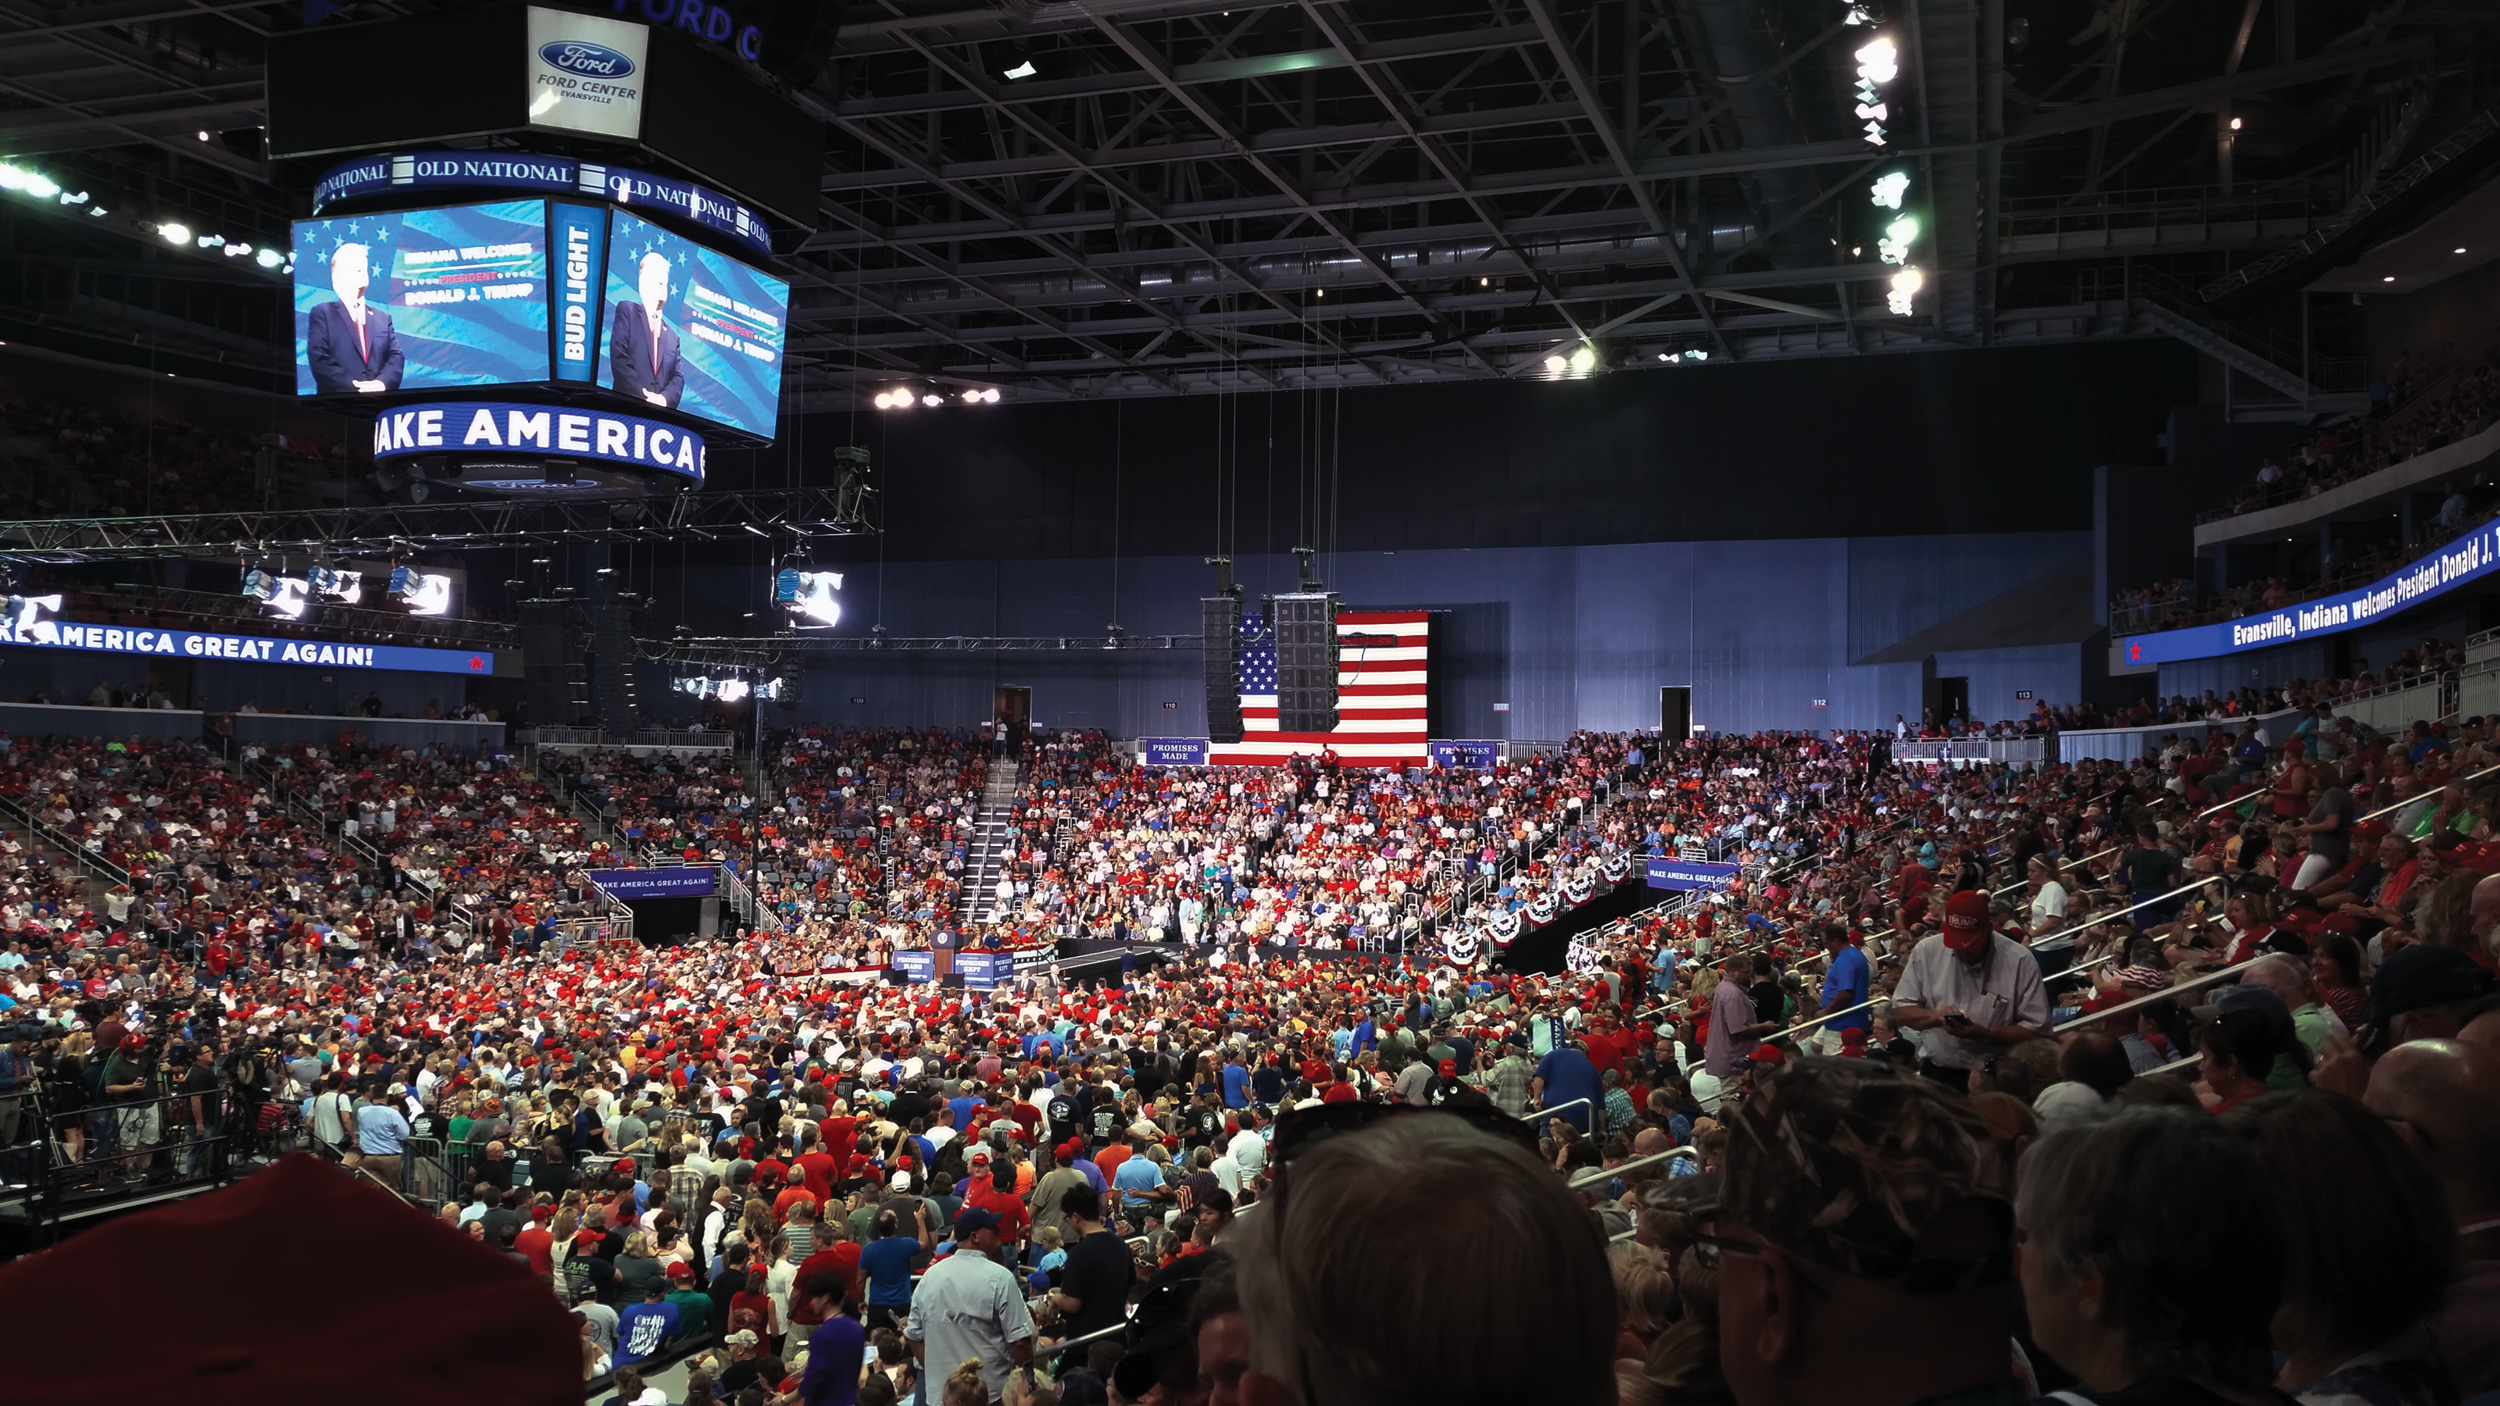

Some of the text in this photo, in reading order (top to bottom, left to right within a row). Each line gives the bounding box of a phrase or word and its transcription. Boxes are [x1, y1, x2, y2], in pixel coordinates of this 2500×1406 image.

[614, 0, 733, 43] ORD
[557, 45, 617, 75] Ford
[537, 74, 637, 100] FORD CENTER
[560, 90, 612, 105] EVANSVILLE
[327, 164, 388, 194] NATIONAL
[416, 161, 574, 183] OLD NATIONAL
[609, 175, 734, 224] OLD NATIONAL
[750, 220, 764, 242] OLD
[439, 271, 498, 285] PRESIDENT
[564, 226, 590, 361] BUD LIGHT
[716, 318, 755, 339] PRESIDENT
[463, 408, 696, 472] AMERICA
[2233, 613, 2296, 646] Evansville,
[2299, 602, 2348, 632] Indiana
[2352, 584, 2396, 621] welcomes
[2397, 559, 2440, 604] President
[2441, 537, 2479, 583] Donald
[2482, 533, 2493, 565] J.
[184, 635, 274, 660] GREAT
[281, 642, 374, 666] AGAIN!
[2018, 691, 2031, 699] 113
[1152, 744, 1199, 752] PROMISES
[1161, 752, 1189, 760] MADE
[1451, 755, 1478, 763] KPT
[620, 880, 656, 888] AMERICA
[656, 879, 682, 887] GREAT
[682, 878, 709, 886] AGAIN!
[1649, 869, 1667, 879] MAKE
[1667, 871, 1694, 881] AMERICA
[1694, 874, 1716, 883] GREAT
[1949, 915, 1978, 926] TRUMP
